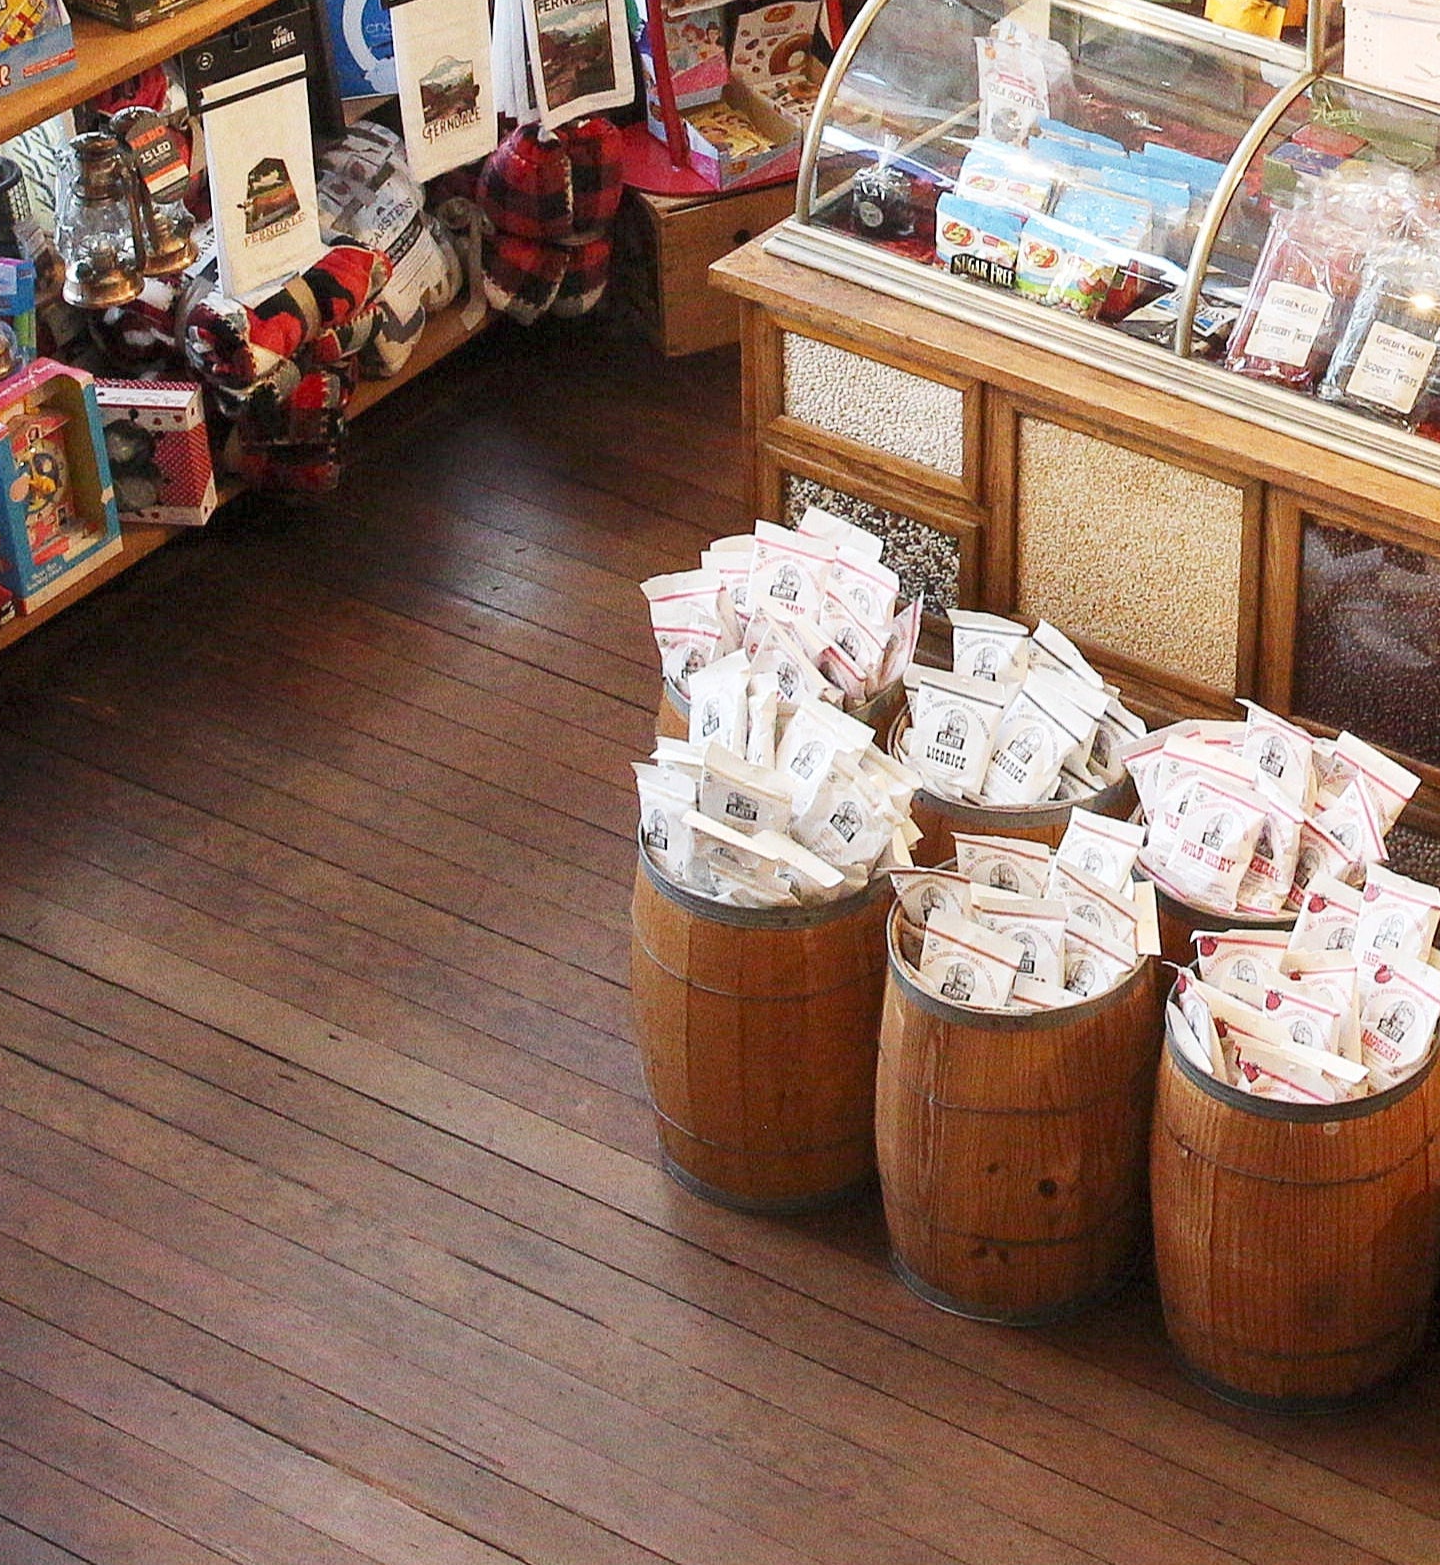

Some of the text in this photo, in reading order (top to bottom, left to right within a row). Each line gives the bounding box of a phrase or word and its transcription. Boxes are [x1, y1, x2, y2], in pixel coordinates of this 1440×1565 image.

[271, 34, 296, 51] TOWEL
[421, 108, 482, 145] FERNDALE
[140, 140, 172, 163] 15 LED
[243, 211, 306, 247] FERNDALE
[953, 253, 1016, 289] SUGAR FREE
[925, 746, 973, 772] LICORICE
[991, 747, 1032, 784] LICORICE
